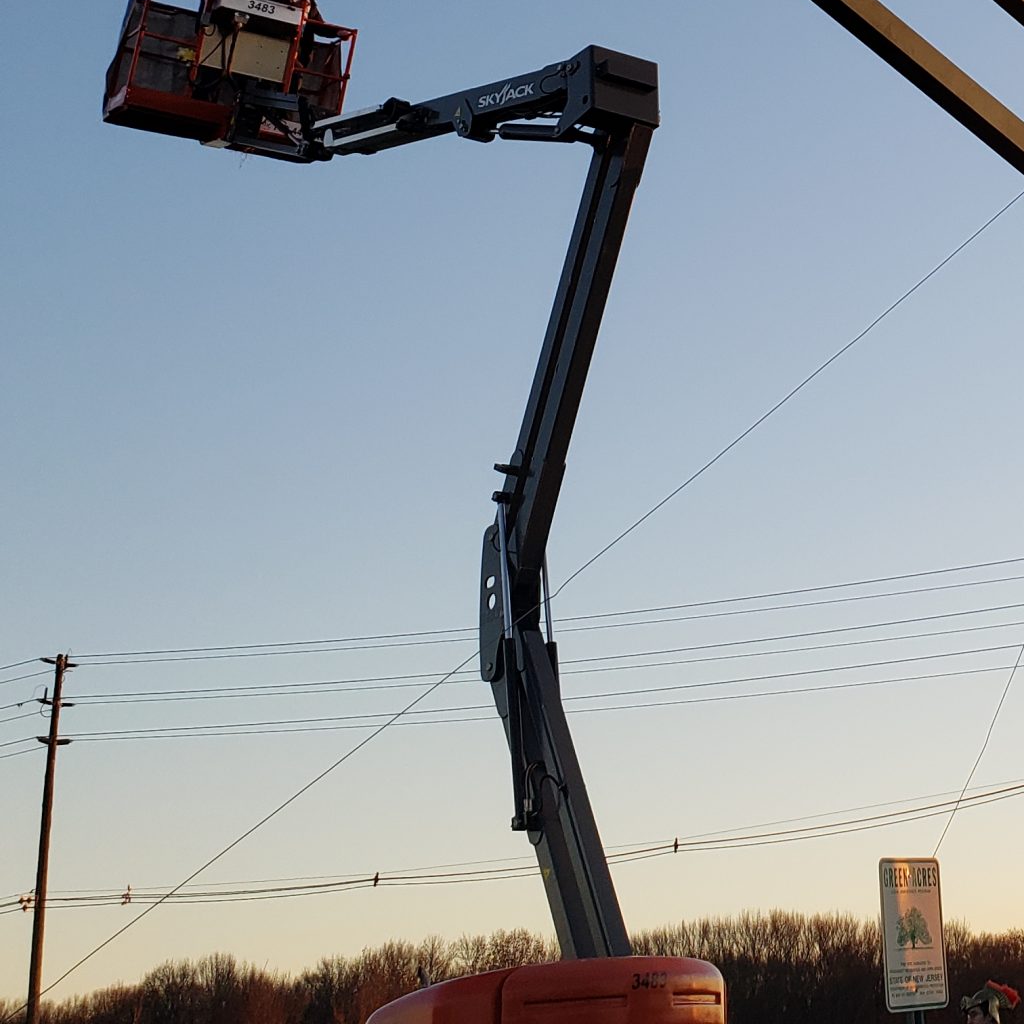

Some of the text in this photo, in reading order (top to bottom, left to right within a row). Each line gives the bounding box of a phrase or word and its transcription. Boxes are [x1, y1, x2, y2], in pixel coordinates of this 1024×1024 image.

[247, 0, 275, 14] 3483
[478, 81, 535, 108] SKYJACK
[883, 866, 937, 888] GREEN ACRES
